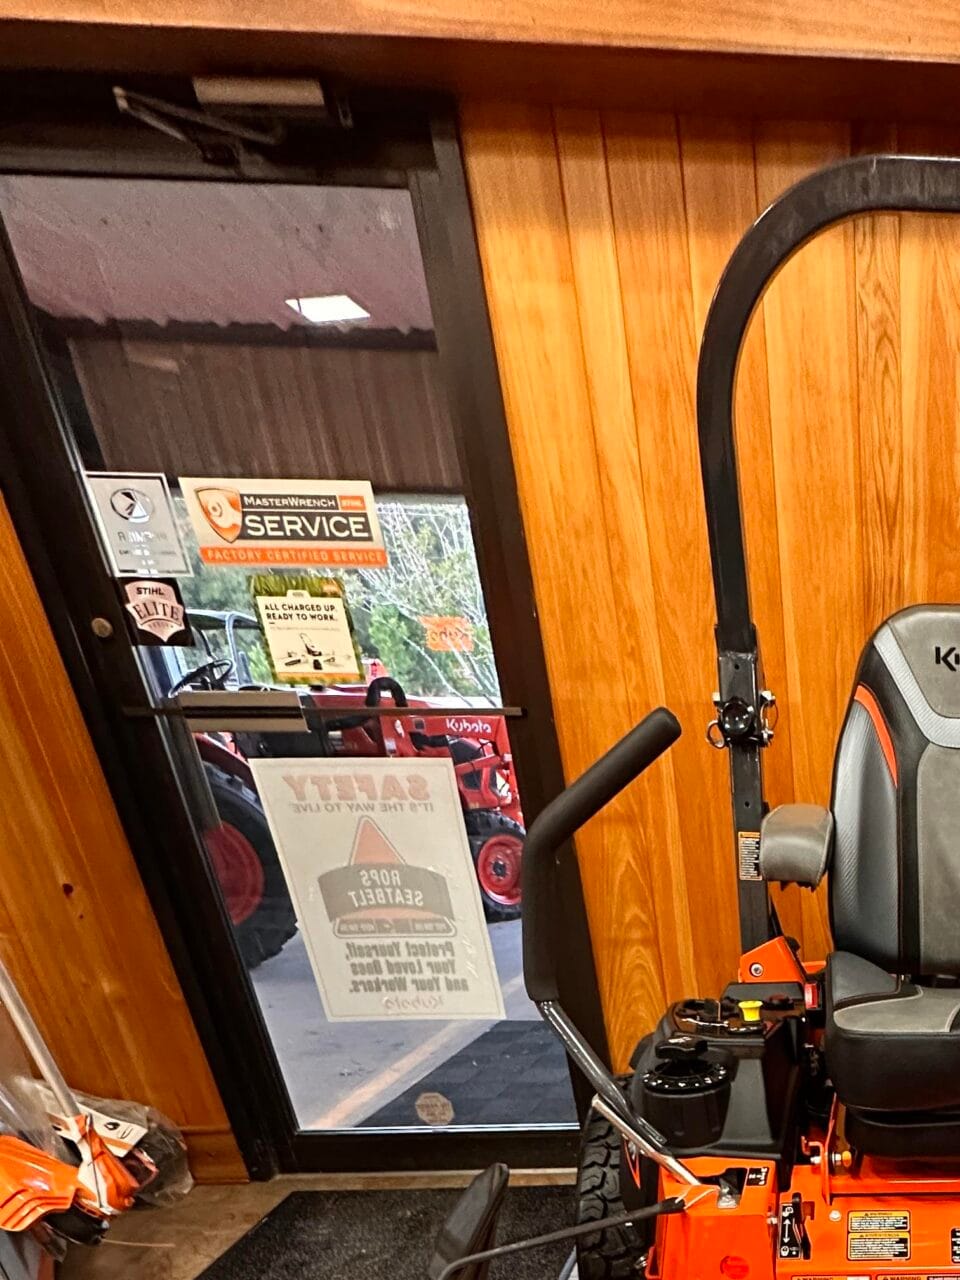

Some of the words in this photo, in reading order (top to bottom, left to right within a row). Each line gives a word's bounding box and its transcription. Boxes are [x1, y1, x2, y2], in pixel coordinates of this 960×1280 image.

[244, 515, 369, 538] SERVICE
[207, 549, 262, 561] FACTORY
[267, 550, 328, 562] CERTIFIED
[333, 551, 384, 563] SERVICE
[136, 586, 165, 596] STIHL
[132, 602, 181, 621] ELITE
[264, 603, 280, 611] ALL
[282, 603, 322, 612] CHARGED
[266, 612, 294, 621] READY
[296, 612, 308, 621] TO
[446, 718, 492, 733] Kubota
